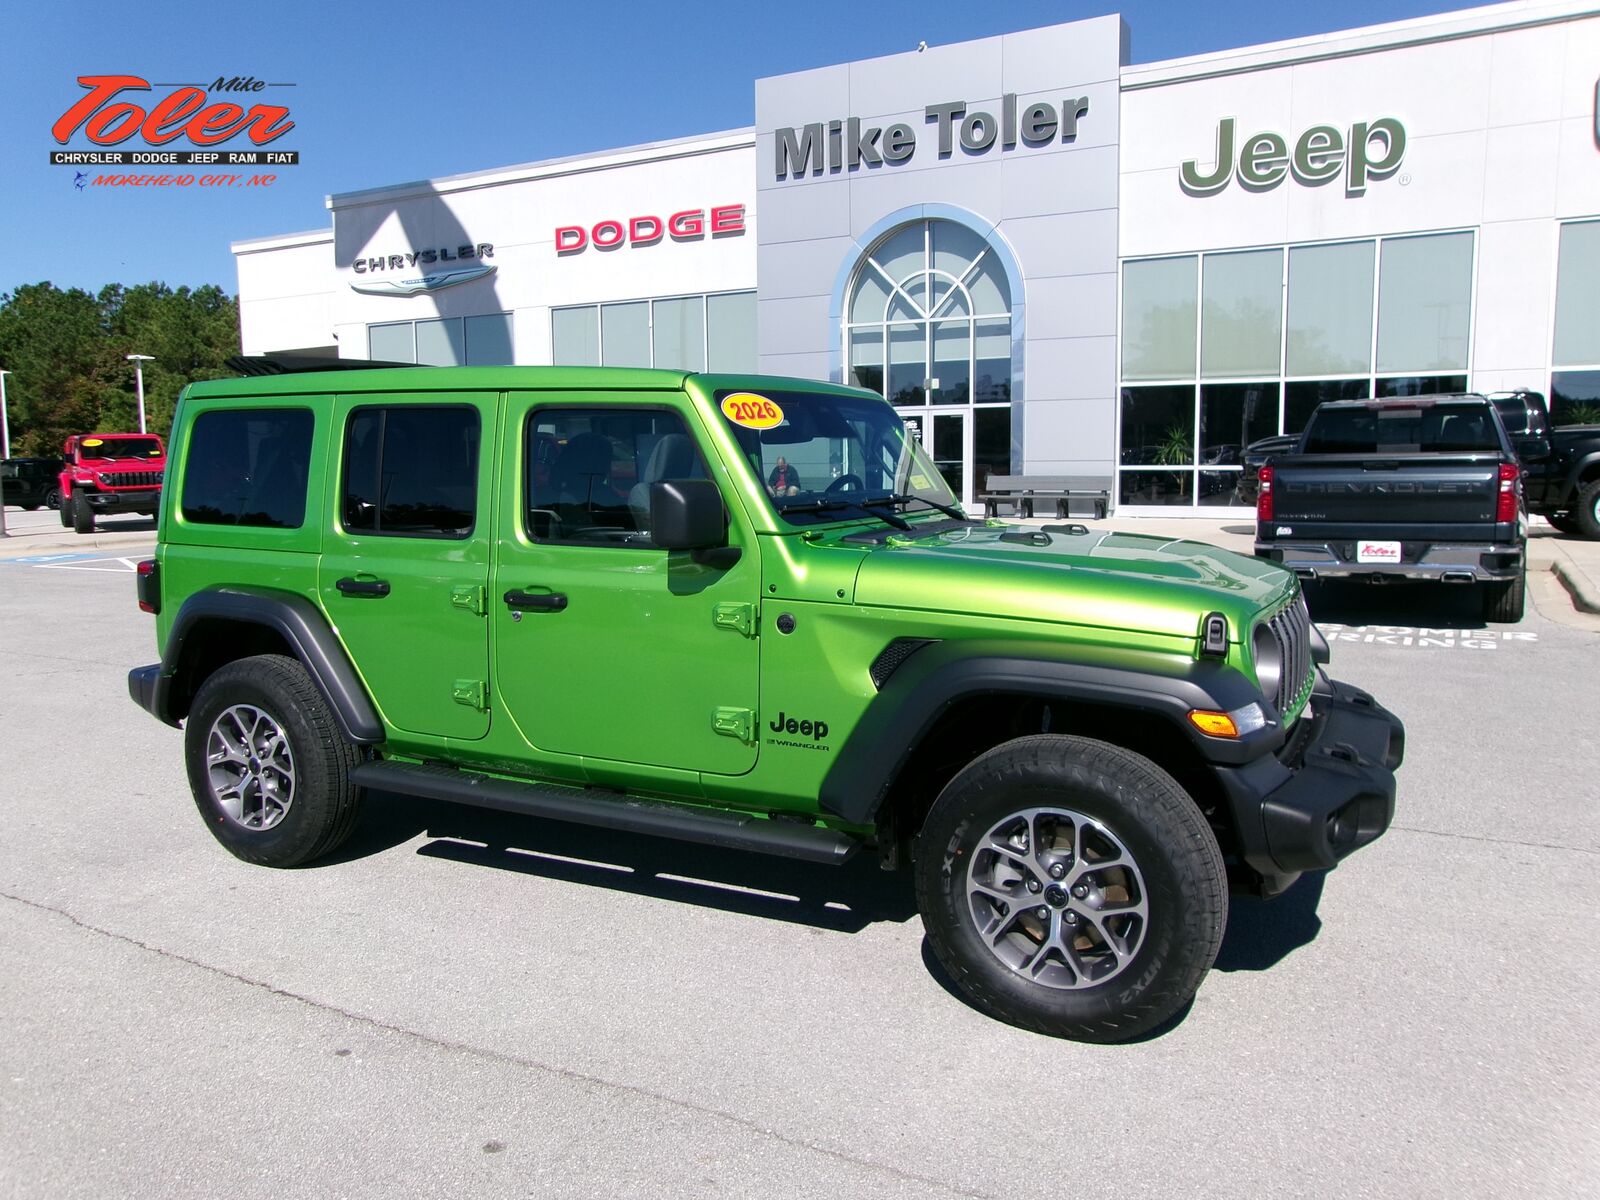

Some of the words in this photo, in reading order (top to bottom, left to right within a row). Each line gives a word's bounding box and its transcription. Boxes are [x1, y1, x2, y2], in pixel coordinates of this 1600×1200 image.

[775, 117, 916, 181] Mike
[925, 93, 1088, 160] Toler
[1179, 115, 1406, 199] Jeep
[555, 204, 746, 257] DODGE
[352, 242, 494, 274] CHRYSLER
[729, 400, 777, 421] 2026
[1314, 623, 1539, 642] STOMER
[1325, 632, 1498, 650] RKING
[769, 711, 829, 741] Jeep
[775, 739, 830, 752] WRANGLER
